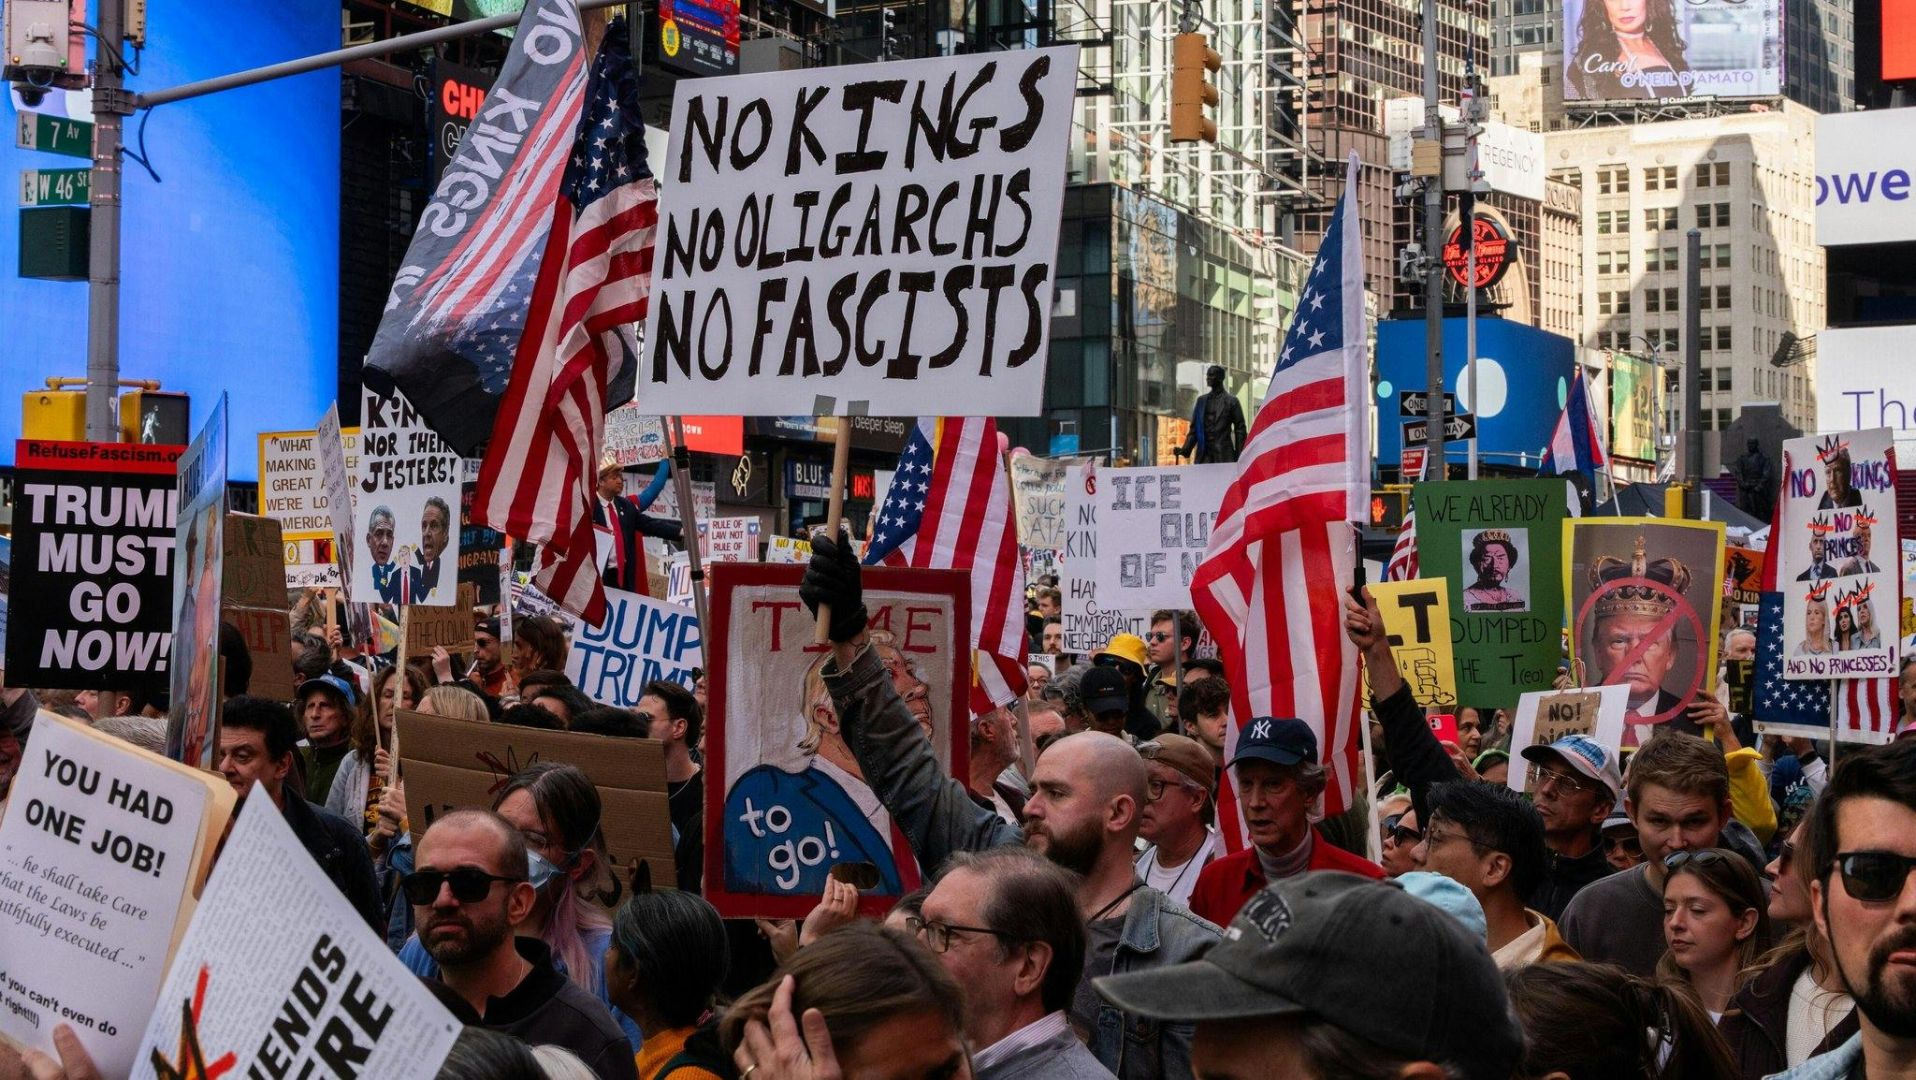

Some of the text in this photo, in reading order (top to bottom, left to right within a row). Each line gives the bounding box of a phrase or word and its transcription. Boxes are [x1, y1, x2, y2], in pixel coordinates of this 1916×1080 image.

[1584, 53, 1640, 75] Carol
[1621, 71, 1754, 88] O'NEIL D'AMATO
[678, 54, 1051, 183] NO KINGS
[50, 121, 80, 148] 7 Av
[1485, 143, 1536, 173] REGENCY
[40, 171, 87, 200] W 46 St
[662, 167, 1033, 280] NO OLIGARCHS
[1480, 256, 1504, 264] GLAZED
[652, 262, 1049, 384] NO FASCISTS
[1408, 400, 1424, 409] ONE
[1842, 388, 1916, 431] Th
[884, 418, 905, 438] sleep
[1414, 423, 1464, 438] ON WAY
[280, 438, 313, 452] WHAT
[364, 432, 398, 457] NOR
[266, 458, 316, 473] MAKING
[361, 456, 457, 493] JESTERS!
[1791, 460, 1893, 498] NO KINGS
[273, 477, 313, 491] GREAT
[1111, 474, 1181, 510] ICE
[266, 497, 303, 511] WE'RE
[1427, 494, 1548, 523] WE ALREADY
[712, 520, 743, 529] RULE OF
[712, 530, 743, 540] LAW NOT
[1834, 512, 1852, 533] NO
[38, 532, 176, 577] MUST
[713, 542, 743, 551] RULE OF
[1120, 552, 1167, 588] OF
[69, 581, 141, 623] GO
[582, 599, 701, 662] DUMP
[752, 601, 942, 654] TME
[1065, 614, 1144, 634] IMMIGRANT
[1450, 618, 1547, 644] DUMPED
[39, 629, 172, 671] NOW!
[1035, 655, 1049, 663] THIS
[1787, 659, 1807, 674] AND
[1829, 646, 1895, 675] PRINCESSES!
[1548, 702, 1582, 722] NO!
[1250, 719, 1272, 739] NY
[43, 748, 174, 826] YOU HAD
[739, 797, 792, 837] to
[25, 798, 167, 878] ONE JOB!
[768, 820, 840, 890] go!
[23, 855, 39, 875] he
[41, 866, 79, 891] shall
[77, 881, 109, 906] take
[111, 896, 149, 922] Care
[27, 886, 48, 905] the
[49, 896, 87, 922] Laws
[90, 911, 107, 931] be
[54, 926, 124, 963] executed
[8, 978, 118, 1036] you can't even do
